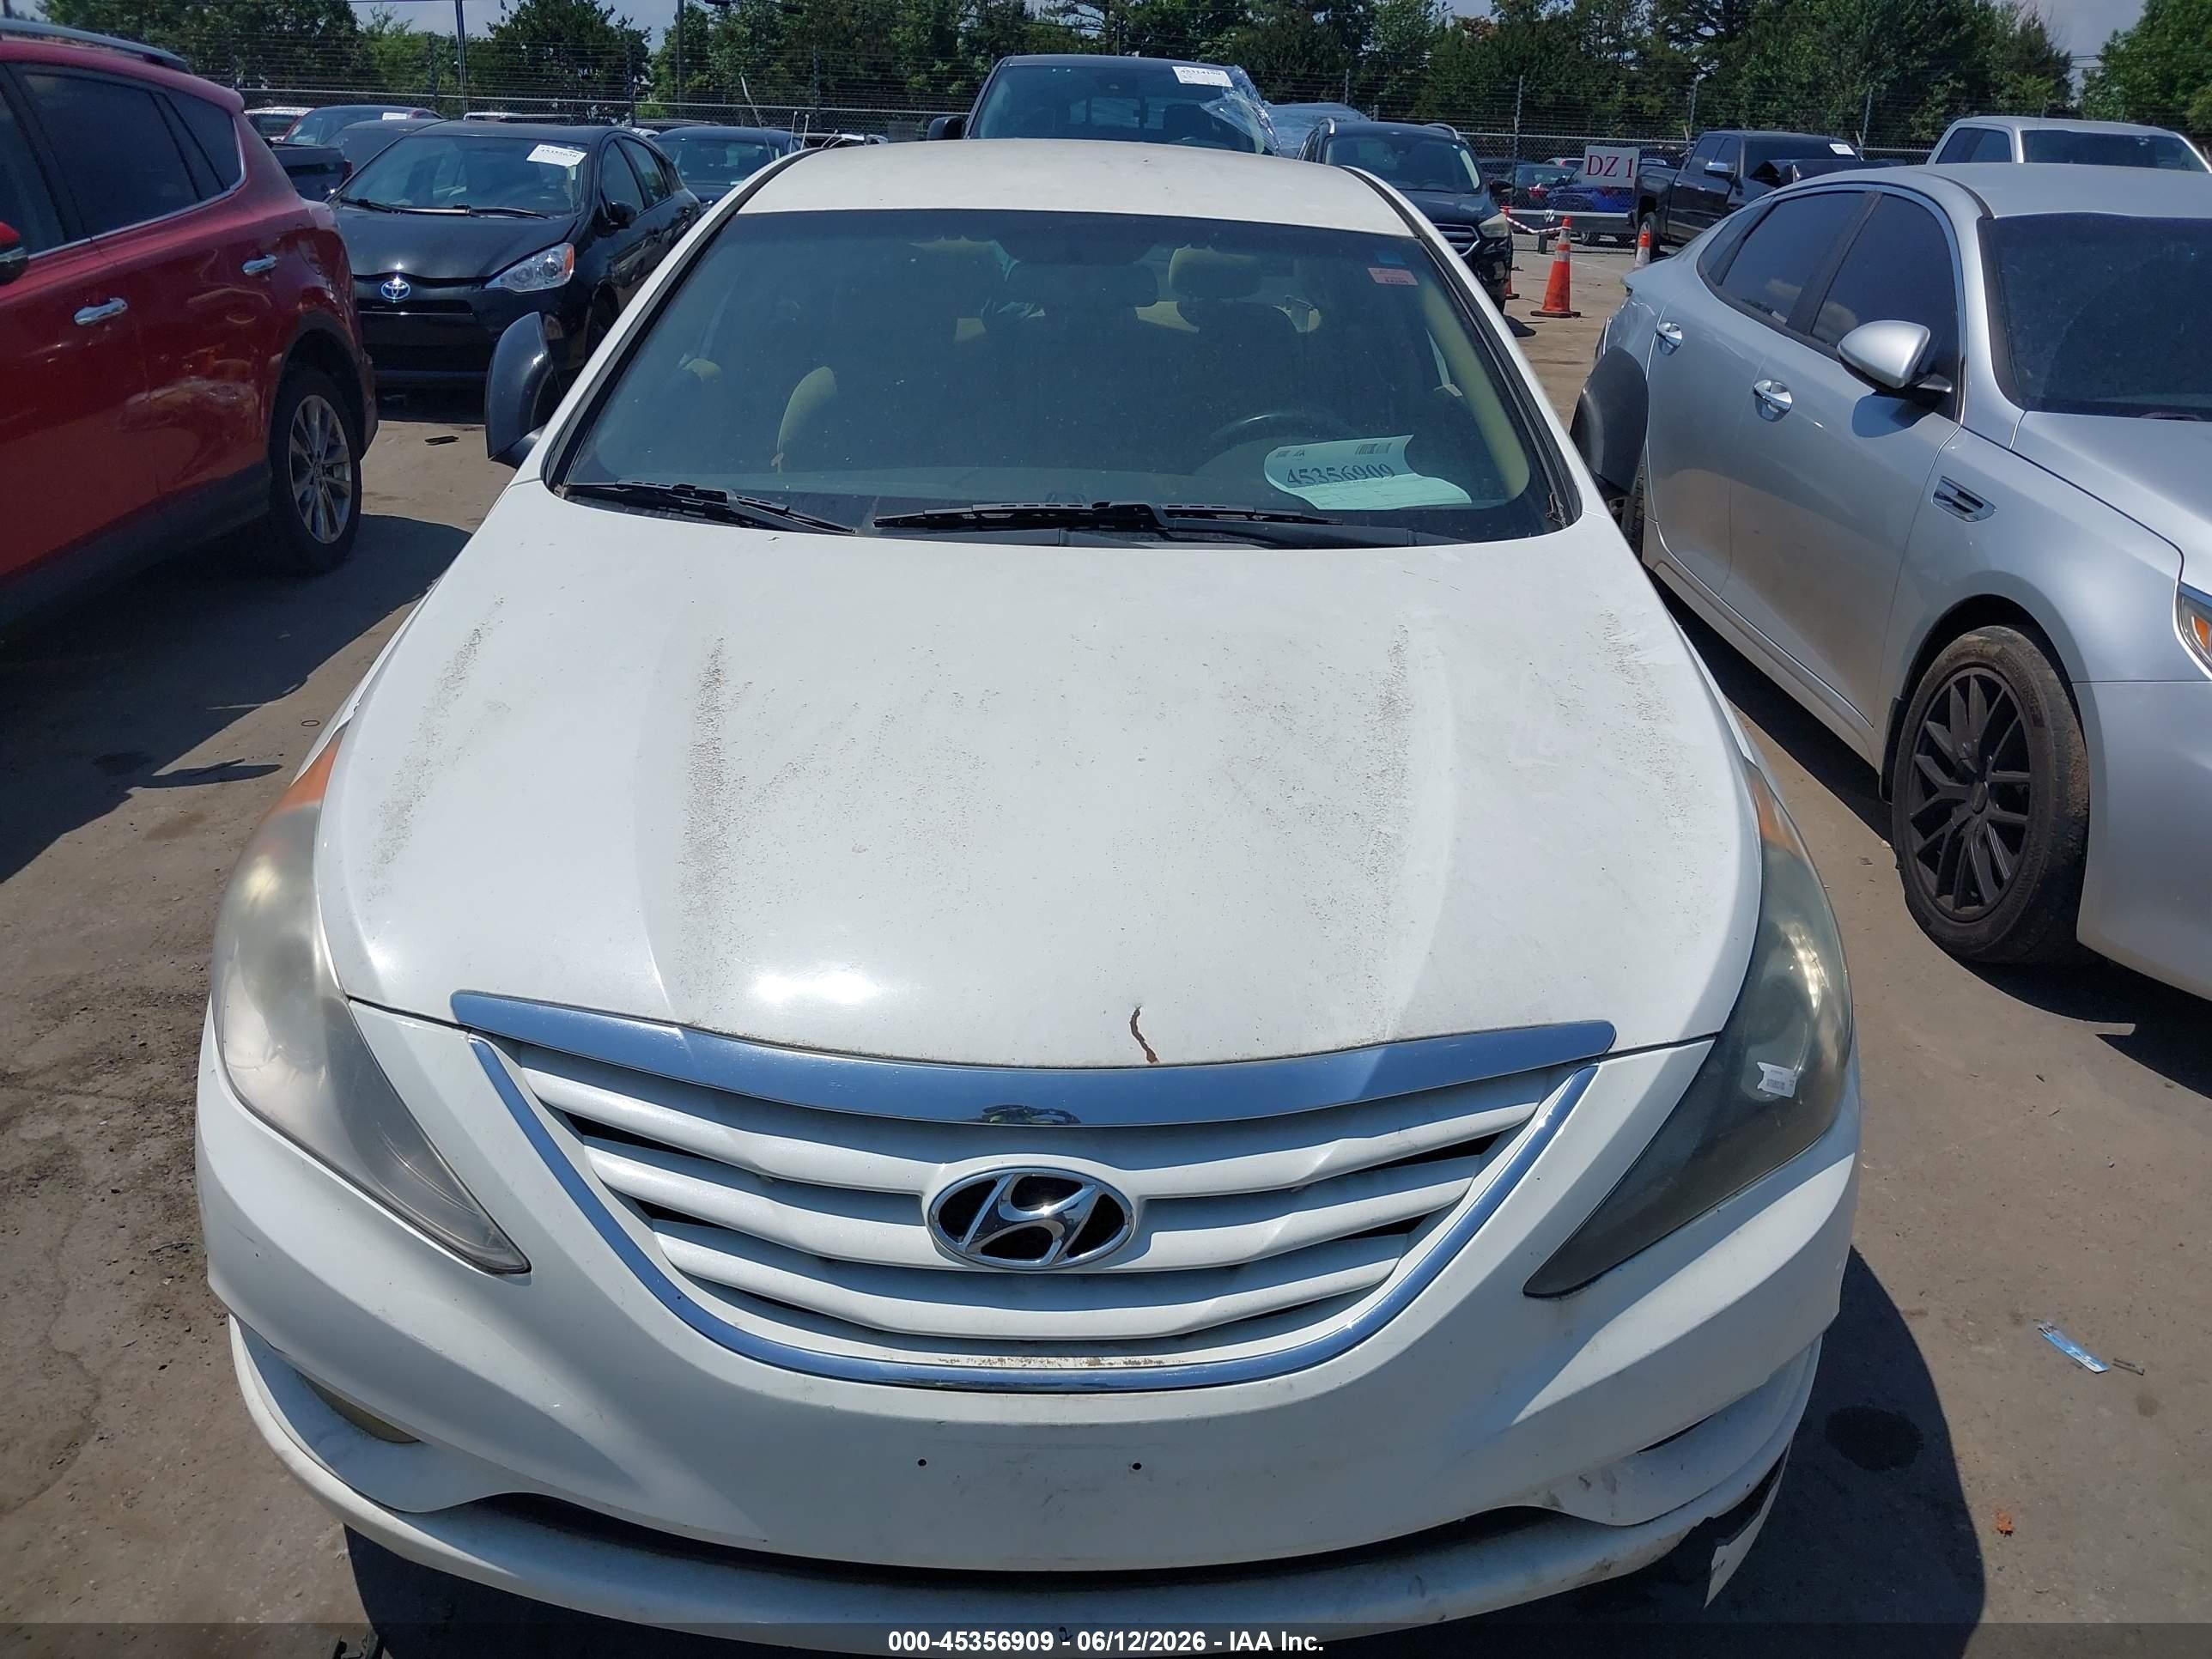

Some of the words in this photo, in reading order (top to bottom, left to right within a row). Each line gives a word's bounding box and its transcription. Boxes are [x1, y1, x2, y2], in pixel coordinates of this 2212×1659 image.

[1586, 155, 1620, 178] DZ
[1626, 157, 1633, 179] 1
[1287, 463, 1395, 485] 45356909
